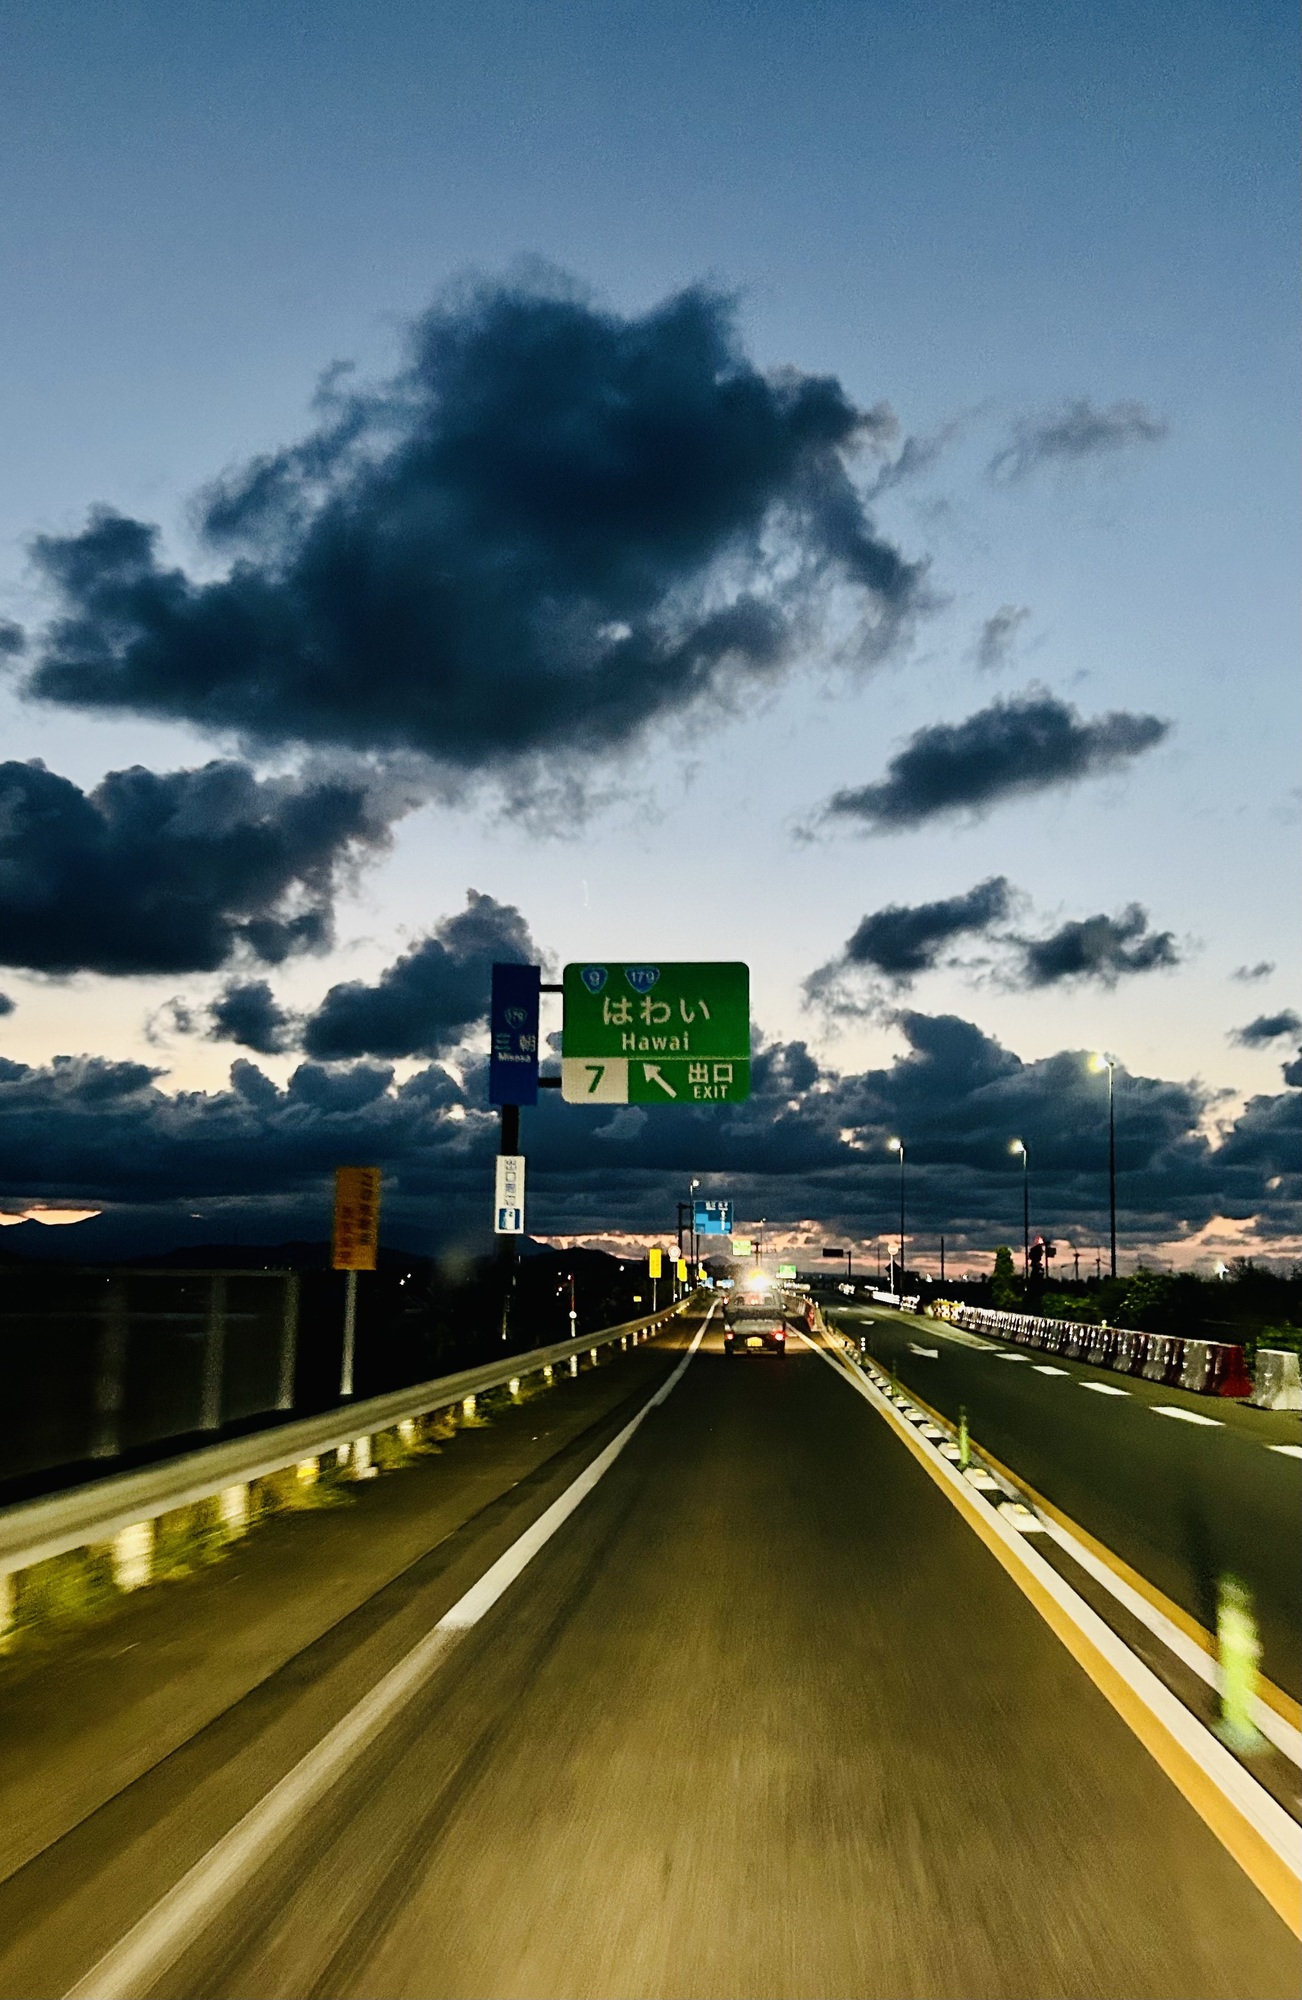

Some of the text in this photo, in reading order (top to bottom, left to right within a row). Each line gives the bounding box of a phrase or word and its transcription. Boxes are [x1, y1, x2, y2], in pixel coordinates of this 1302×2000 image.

[589, 970, 600, 987] 9
[631, 970, 656, 984] 179
[602, 995, 711, 1026] はわい
[621, 1031, 690, 1052] Hawai
[585, 1065, 605, 1094] 7
[688, 1062, 734, 1084] 出口
[693, 1084, 729, 1099] EXIT
